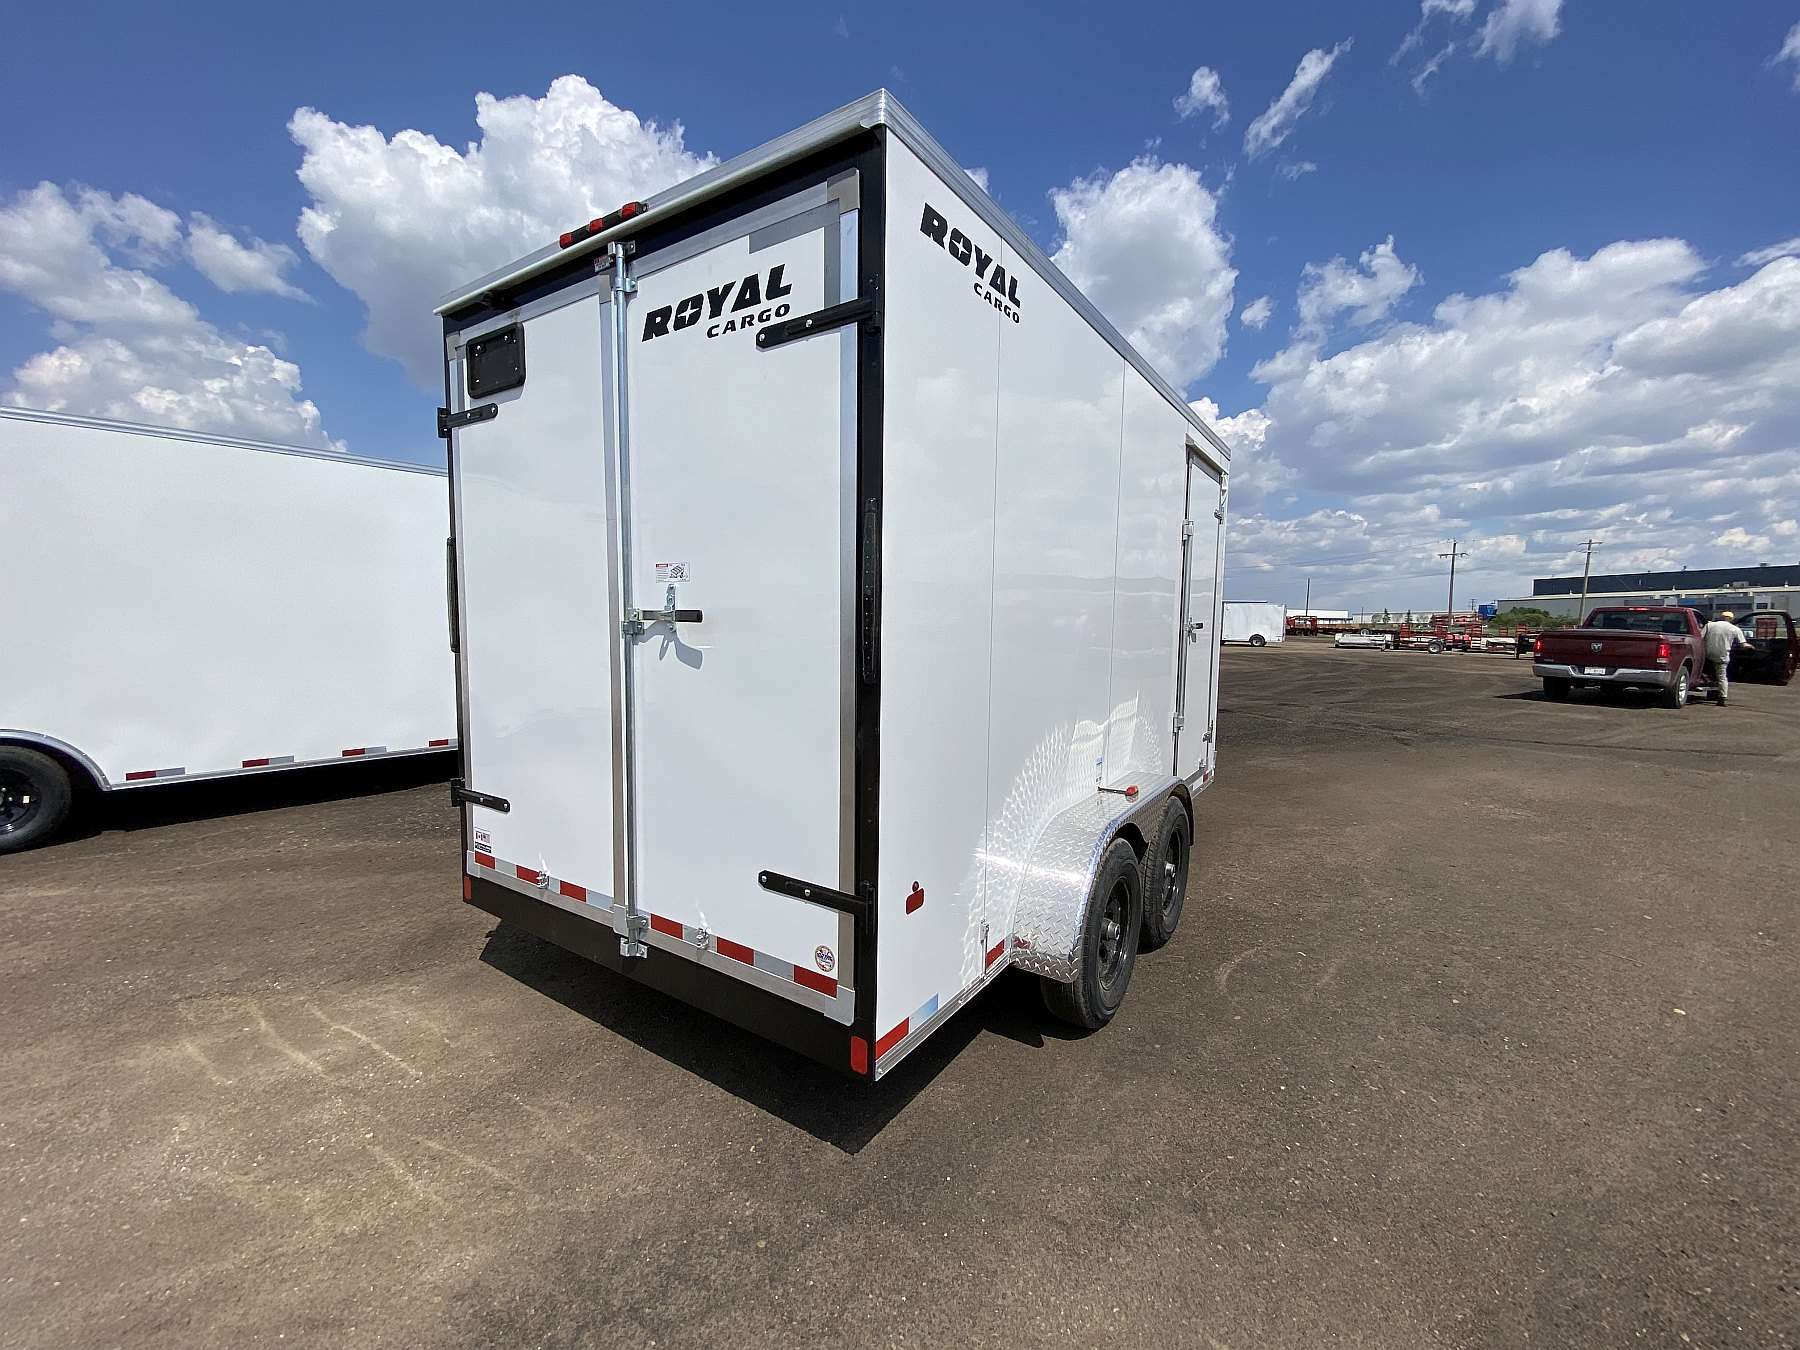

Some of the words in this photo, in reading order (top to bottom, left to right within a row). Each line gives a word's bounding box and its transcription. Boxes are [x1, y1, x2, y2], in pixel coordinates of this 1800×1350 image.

[920, 202, 1021, 309] ROYAL
[641, 263, 793, 342] ROYAL
[706, 303, 791, 339] CARGO
[973, 282, 1020, 324] CARGO
